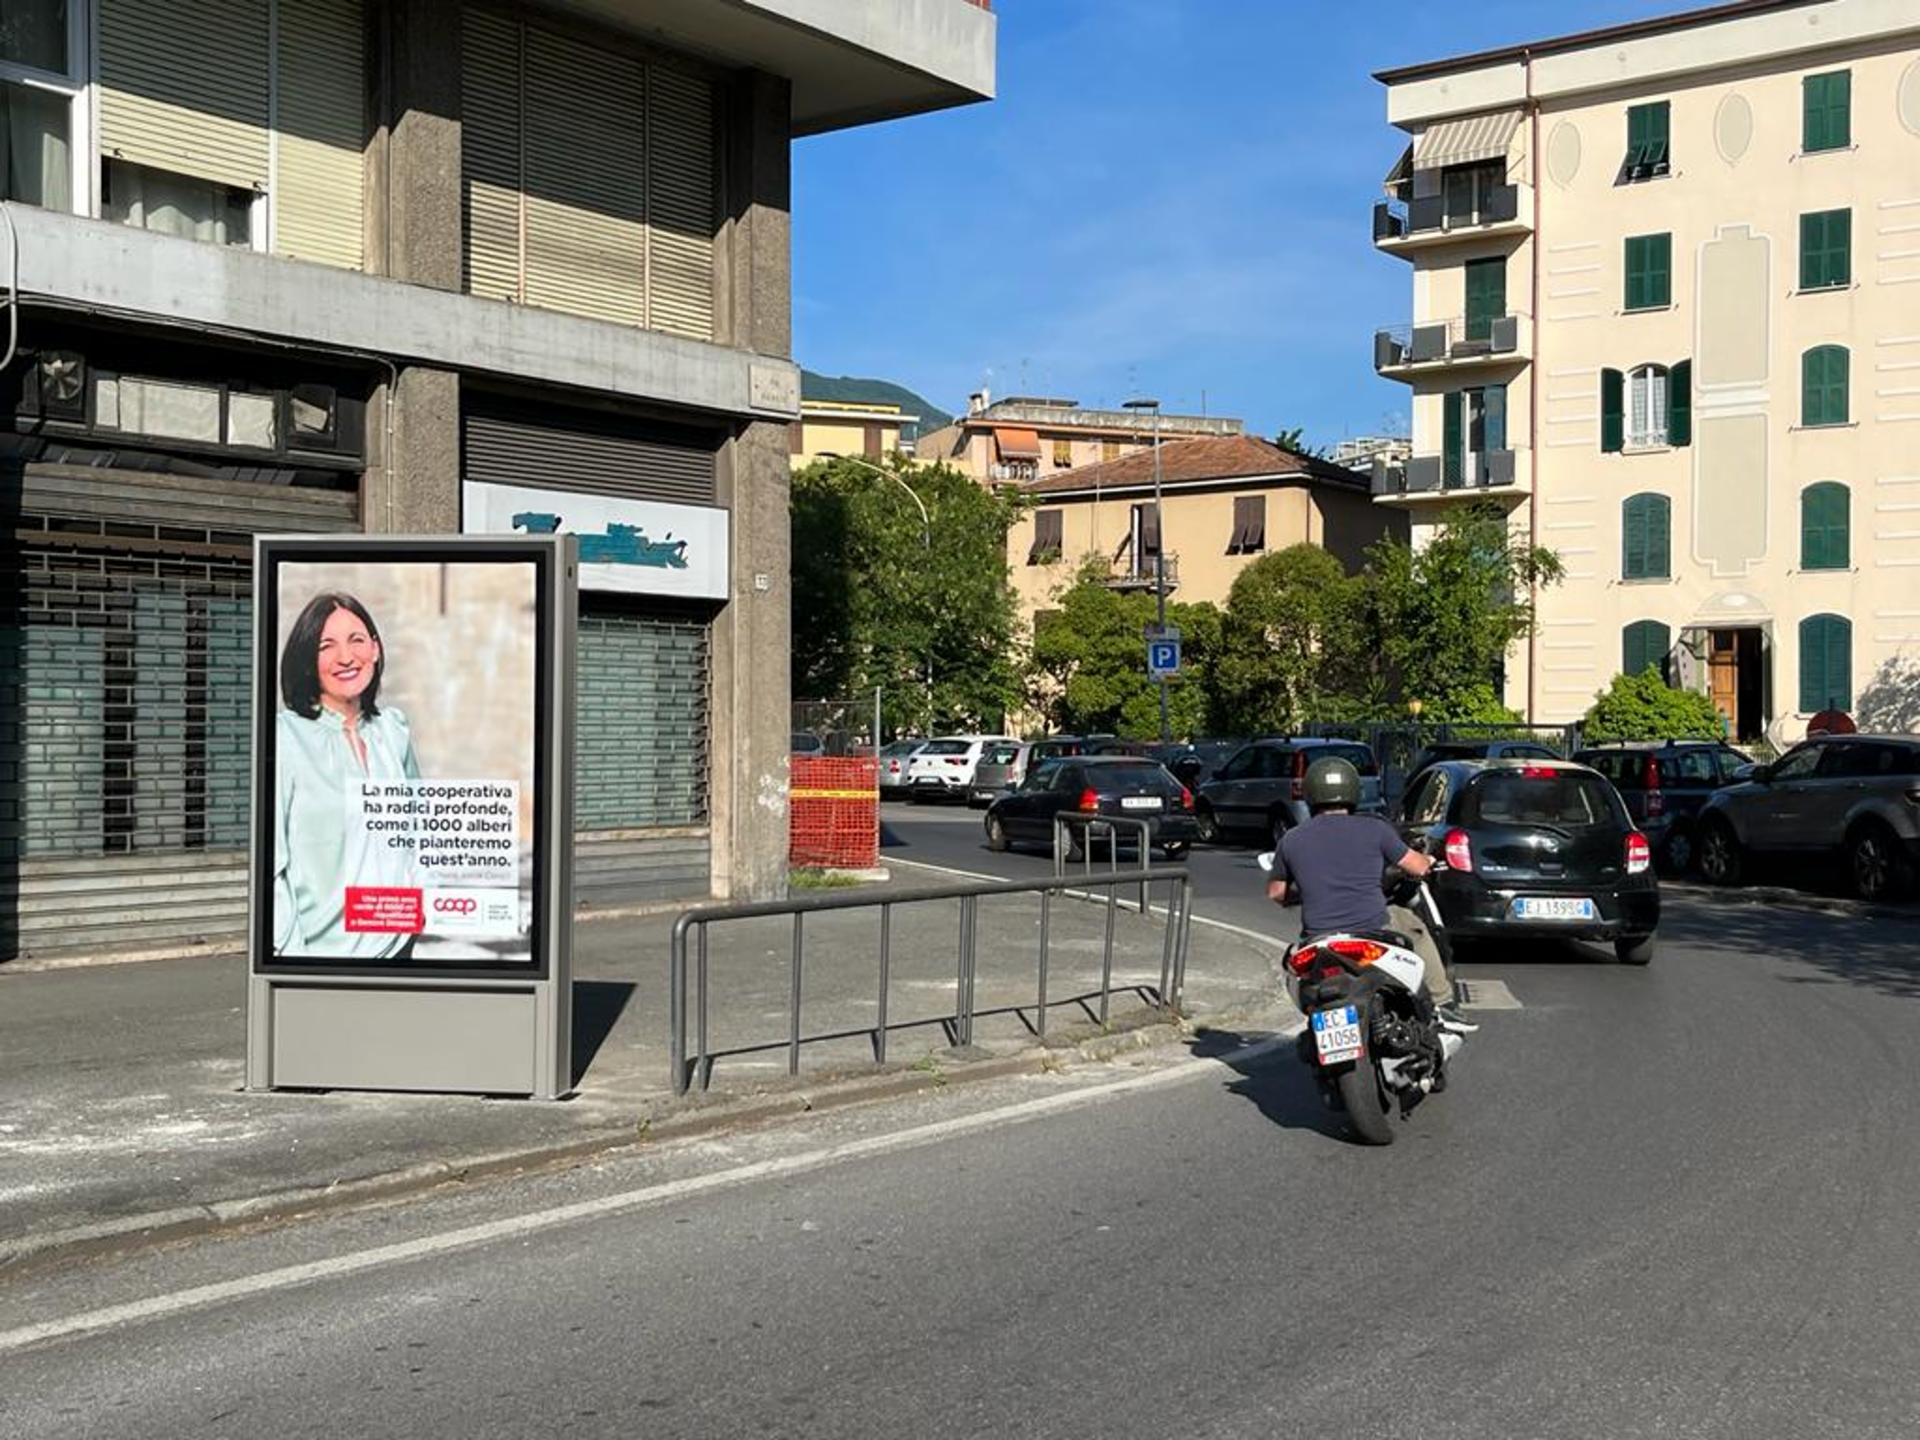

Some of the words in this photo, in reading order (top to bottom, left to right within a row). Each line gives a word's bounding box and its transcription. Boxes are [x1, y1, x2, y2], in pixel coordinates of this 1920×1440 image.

[1158, 647, 1172, 666] P
[362, 783, 380, 796] La
[385, 783, 413, 796] mia
[417, 784, 512, 799] cooperativa
[363, 800, 382, 813] ha
[387, 800, 430, 814] radici
[434, 801, 512, 816] profonde,
[366, 819, 409, 831] come
[413, 818, 418, 831] i
[422, 819, 462, 831] 1000
[467, 818, 512, 832] alberi
[388, 835, 415, 848] che
[419, 835, 511, 850] pianteremo
[419, 853, 511, 868] quest'anno.
[433, 897, 477, 915] coop
